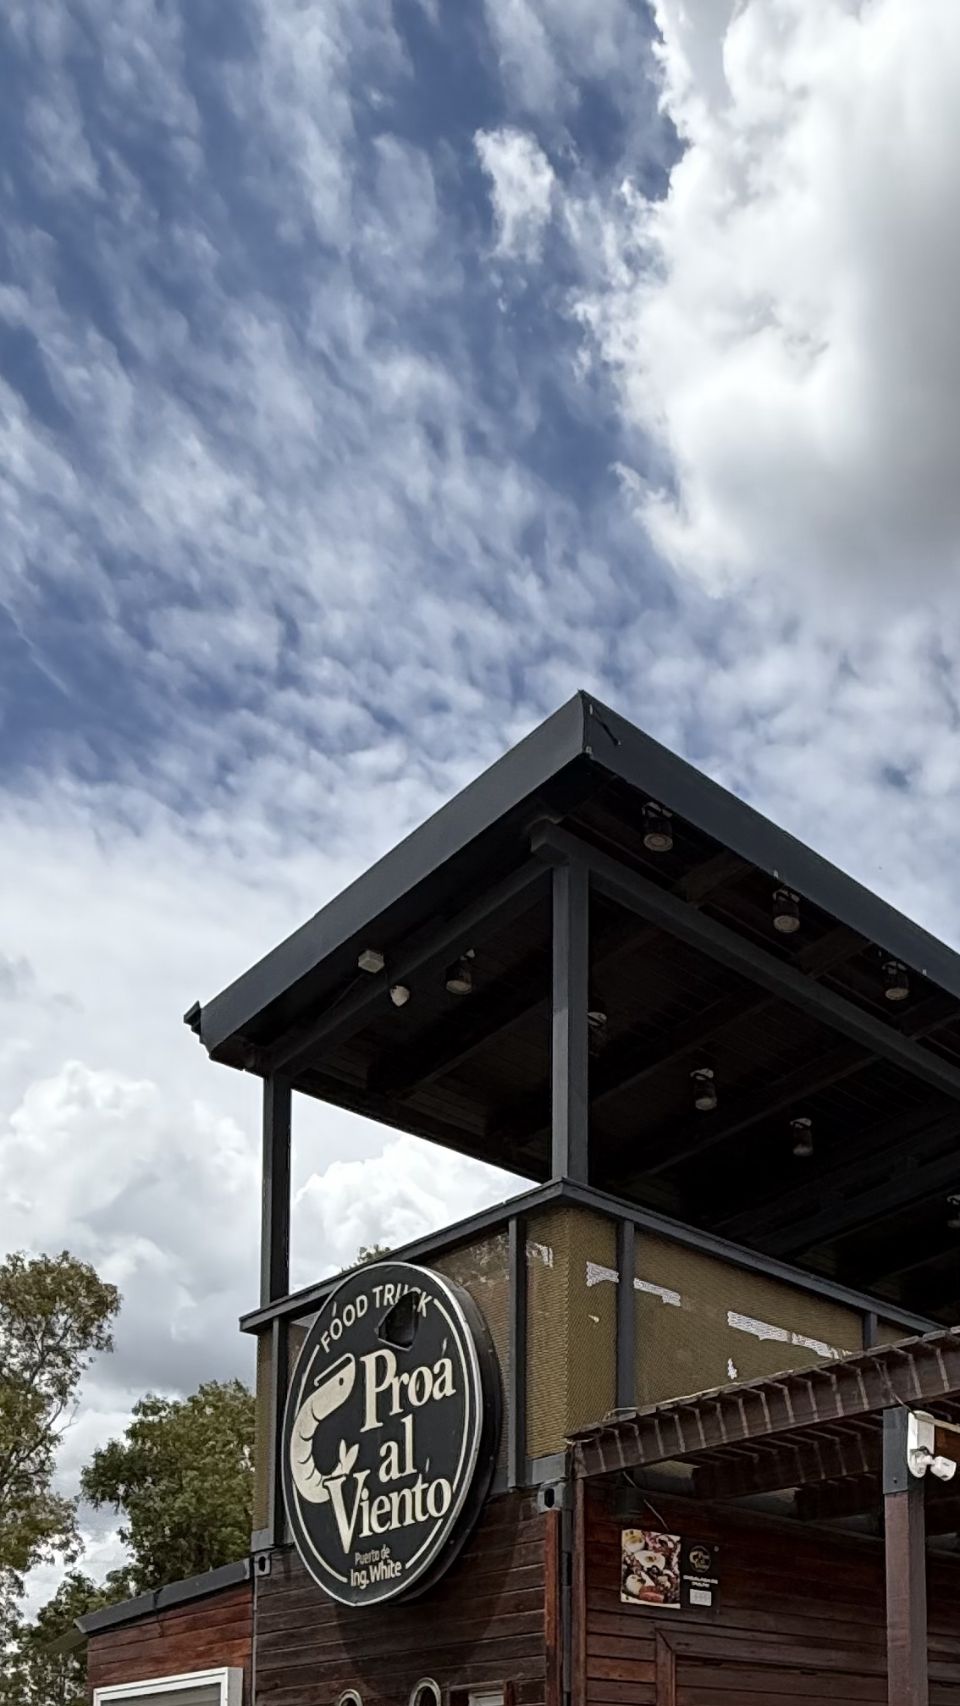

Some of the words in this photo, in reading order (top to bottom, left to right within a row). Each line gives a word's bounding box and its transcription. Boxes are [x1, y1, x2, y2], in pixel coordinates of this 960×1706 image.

[320, 1295, 368, 1353] FOOD
[360, 1349, 456, 1432] Proa
[379, 1413, 417, 1483] al
[324, 1469, 451, 1554] Viento
[355, 1550, 380, 1566] Puerto
[381, 1544, 391, 1560] de
